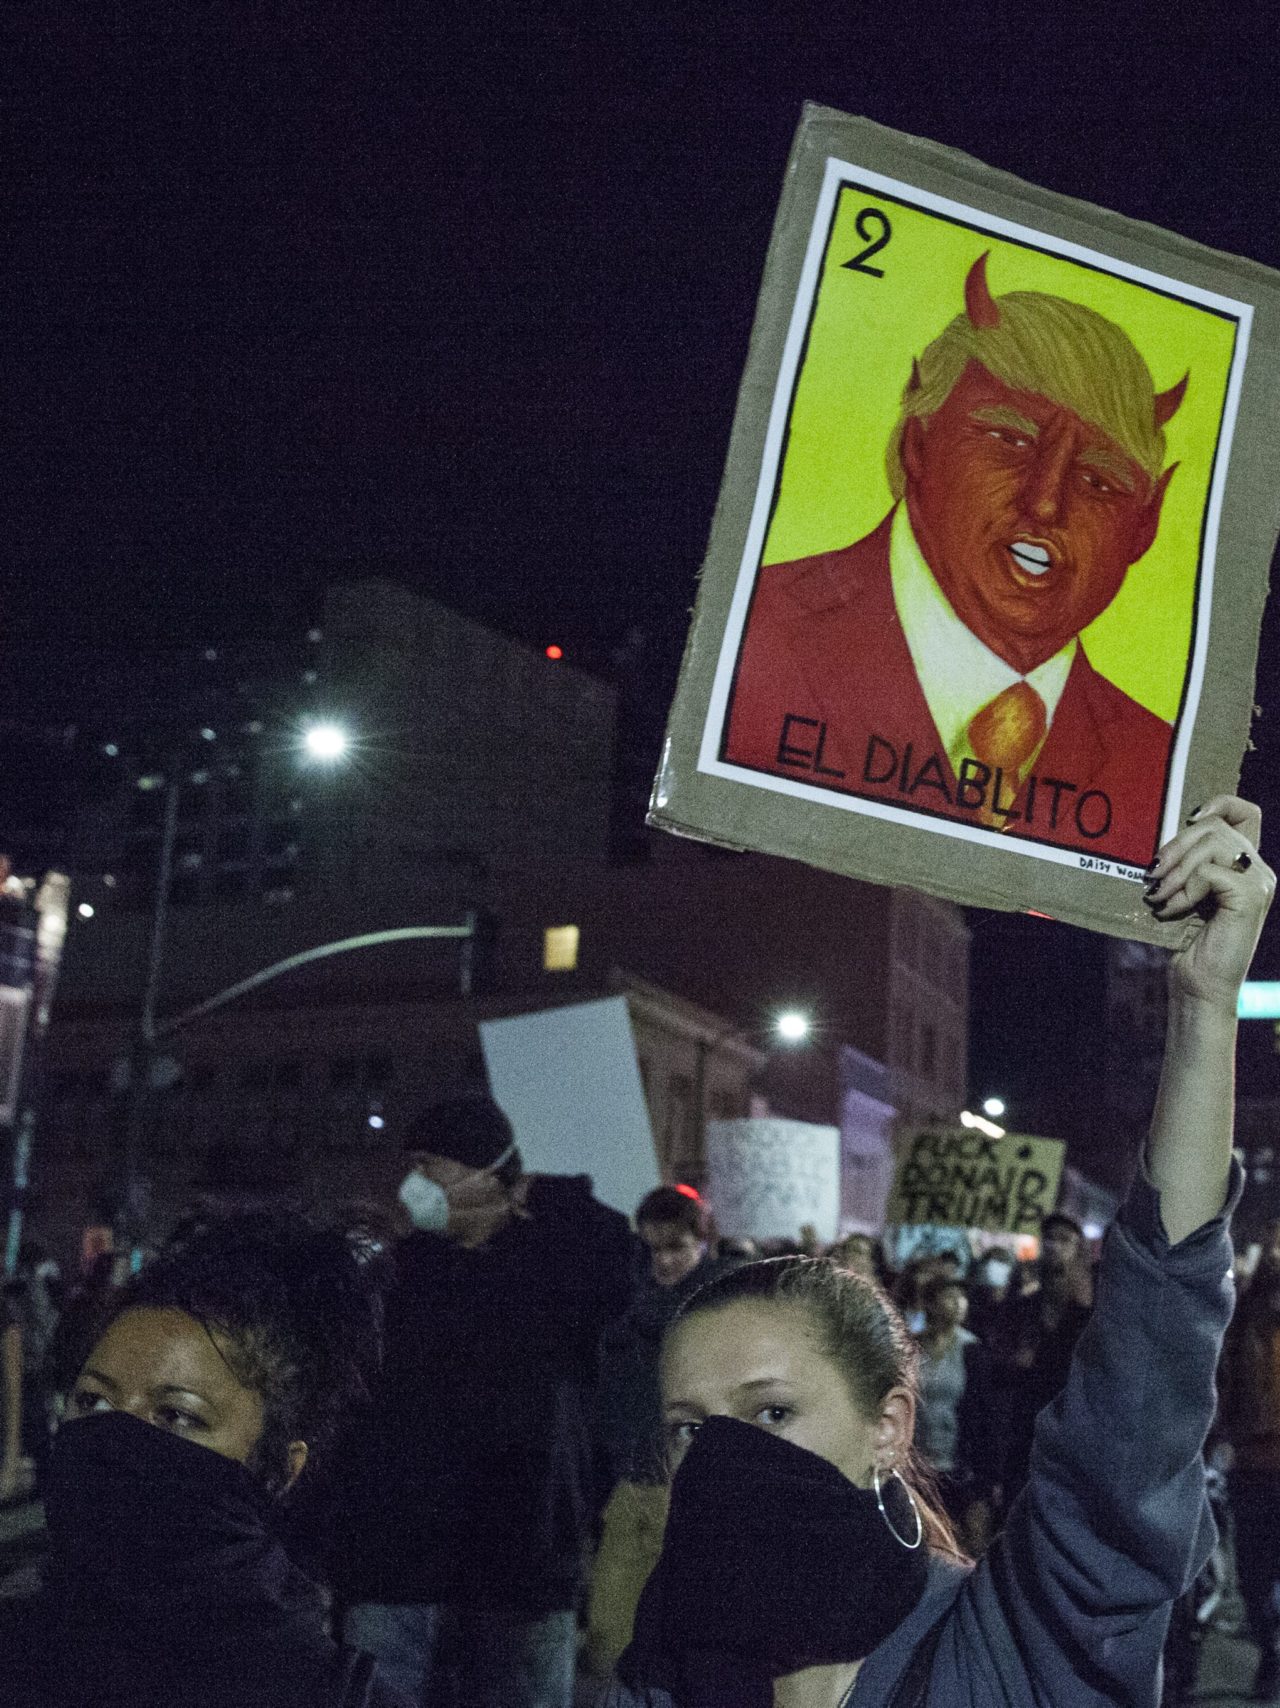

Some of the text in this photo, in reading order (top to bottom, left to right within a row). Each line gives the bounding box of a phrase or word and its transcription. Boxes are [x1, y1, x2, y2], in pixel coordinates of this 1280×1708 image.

[840, 207, 892, 279] 2
[776, 712, 1113, 840] EL DIABLITO
[912, 1133, 999, 1165] FUCK
[899, 1190, 1045, 1234] TRUMP
